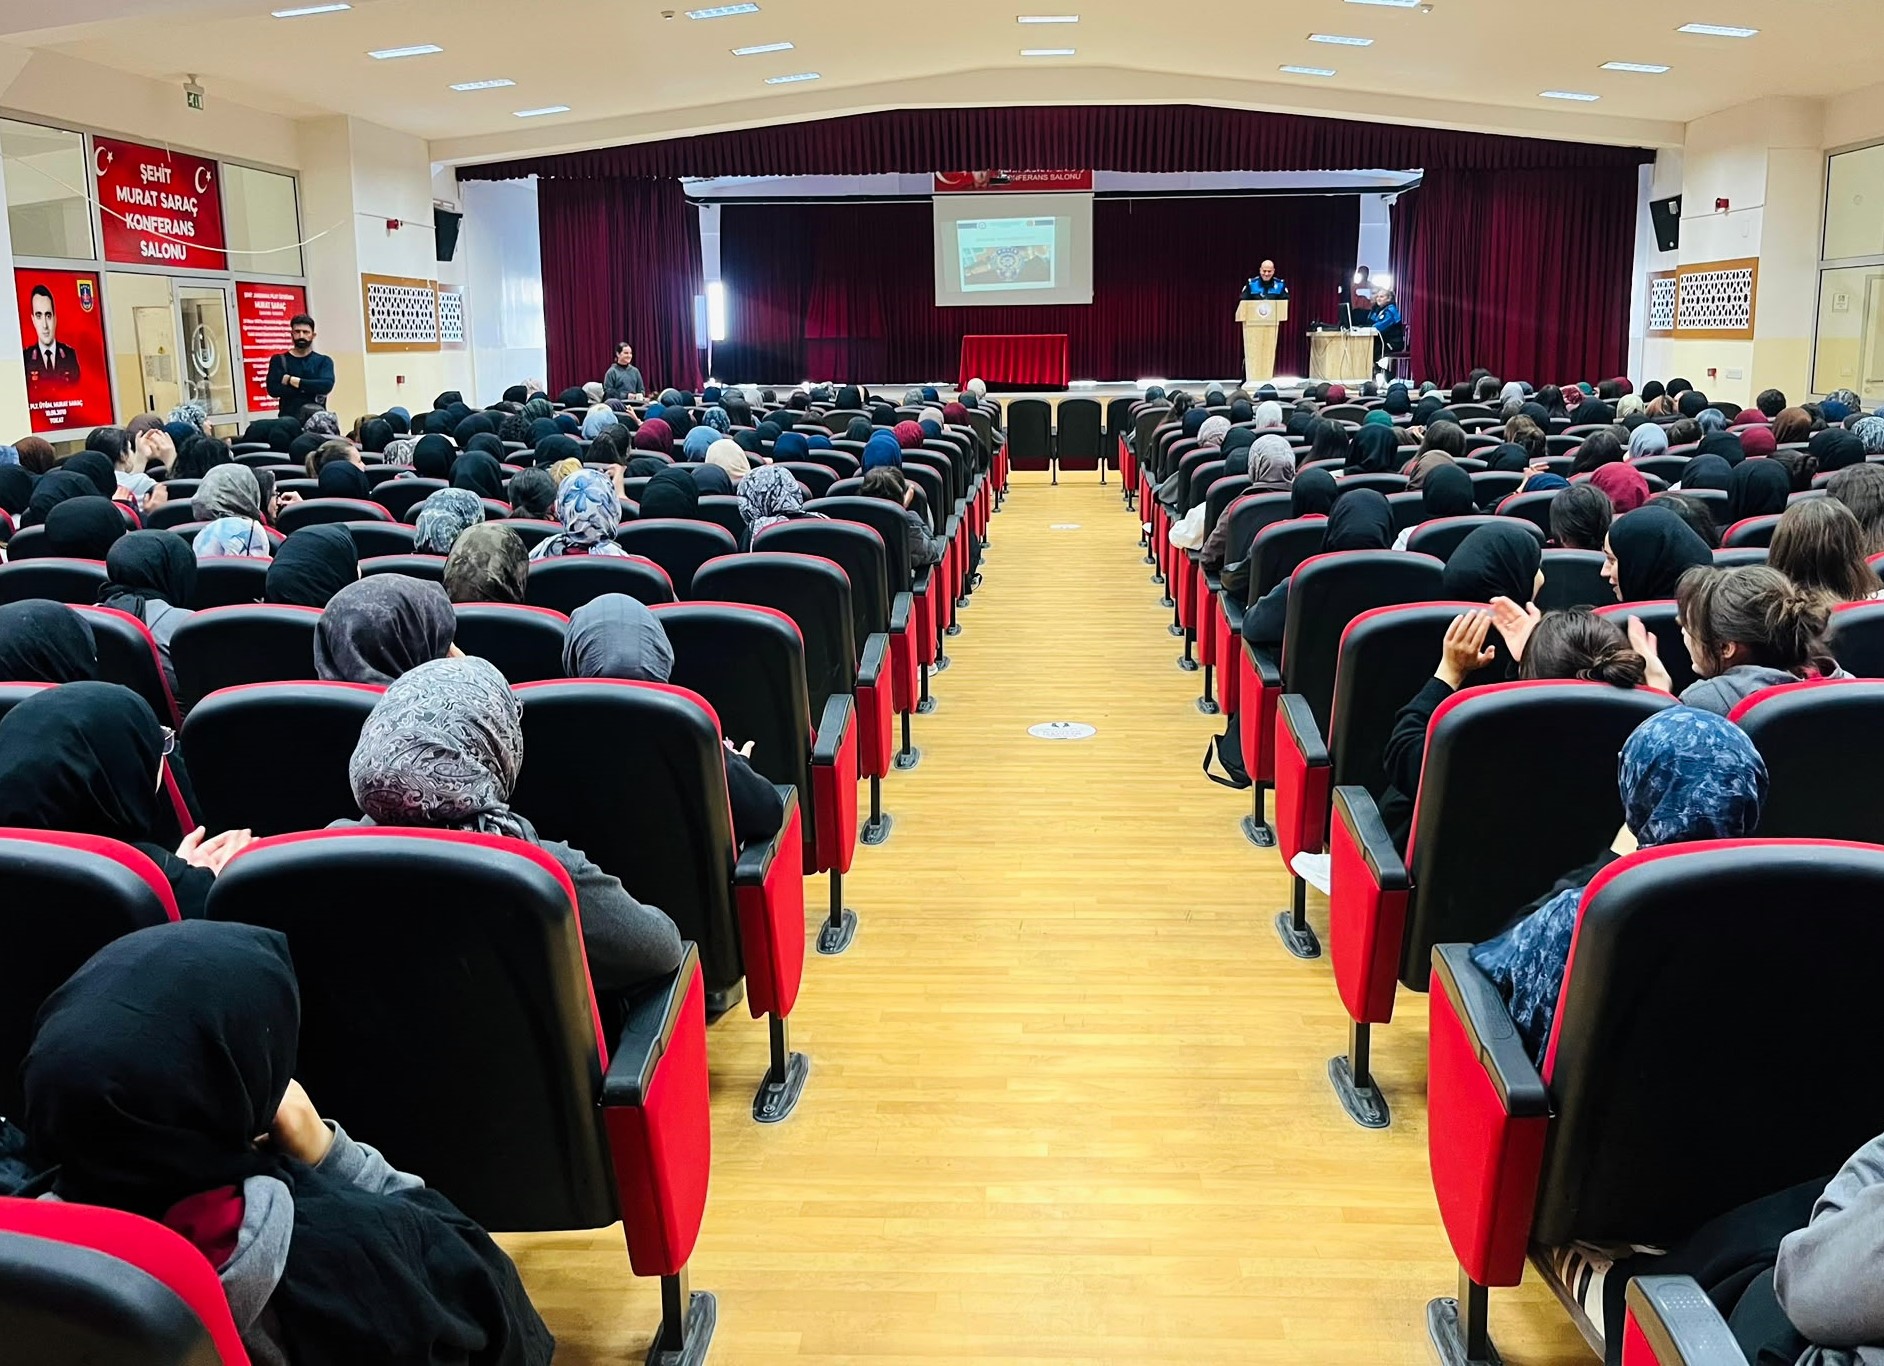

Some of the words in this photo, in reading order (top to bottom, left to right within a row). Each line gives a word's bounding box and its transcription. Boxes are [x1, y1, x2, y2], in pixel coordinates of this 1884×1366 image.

[140, 163, 171, 184] ŞEHİT
[116, 185, 158, 207] MURAT
[160, 192, 198, 217] SARAÇ
[125, 212, 195, 237] KONFERANS
[140, 240, 187, 260] SALONU
